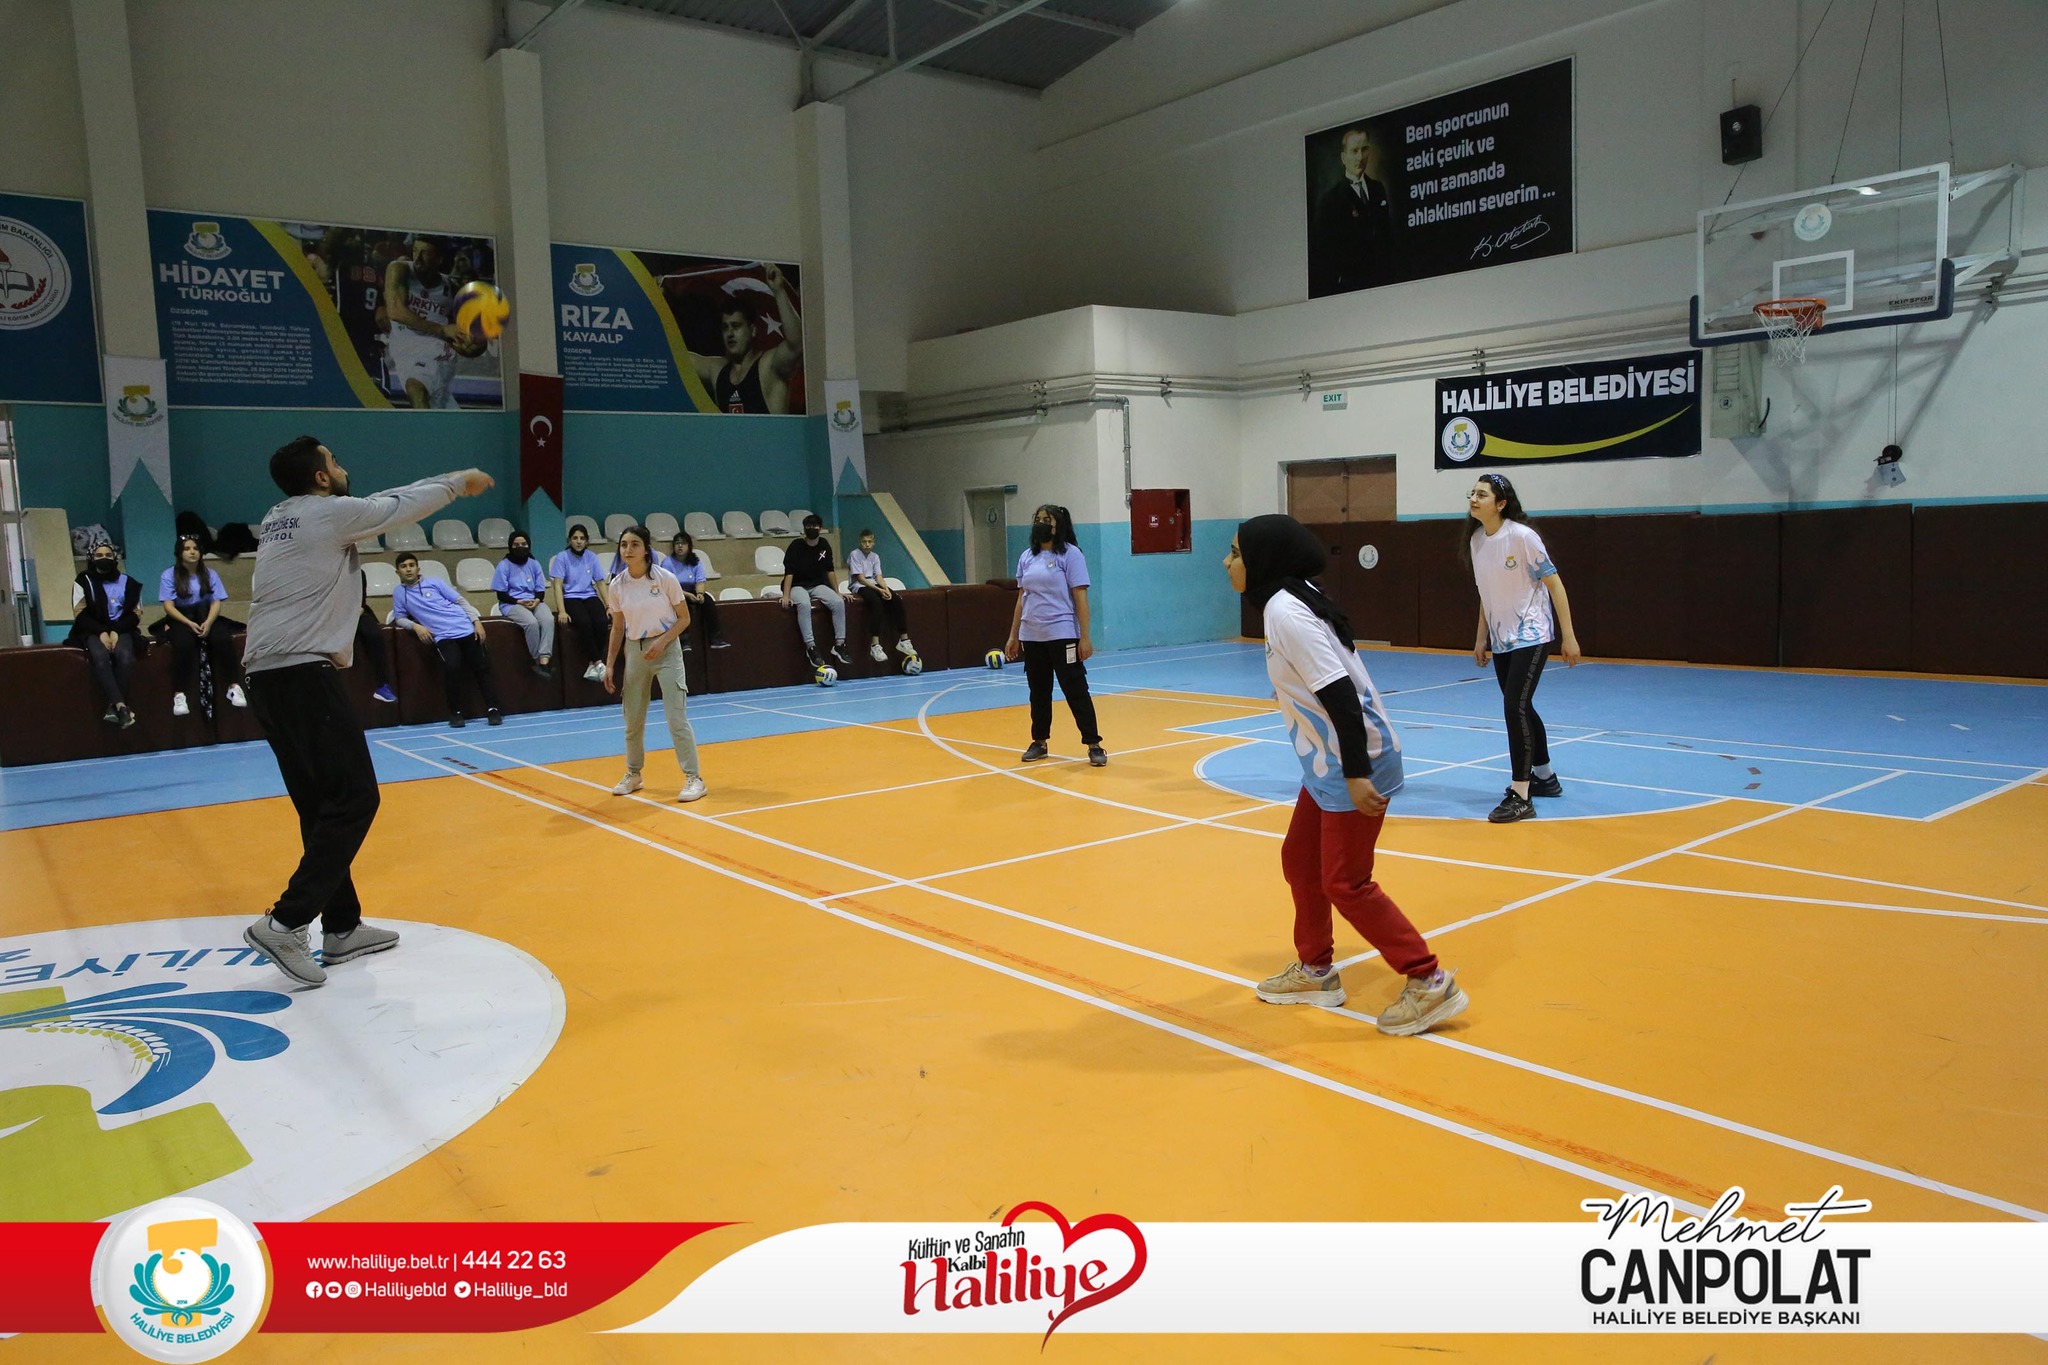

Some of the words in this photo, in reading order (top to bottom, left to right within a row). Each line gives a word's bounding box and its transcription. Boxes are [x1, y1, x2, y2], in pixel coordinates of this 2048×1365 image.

[1406, 125, 1432, 144] Ben
[1434, 102, 1509, 137] sporcunun
[1406, 150, 1433, 172] zeki
[1437, 139, 1474, 168] çevik
[1477, 136, 1495, 154] ve
[1410, 179, 1438, 200] aynı
[1440, 162, 1505, 191] zamanda
[1407, 200, 1476, 227] ahlaklısını
[1479, 184, 1539, 213] severim
[160, 260, 285, 289] HİDAYET
[177, 285, 272, 304] TÜRKOĞLU
[365, 287, 379, 310] 9
[561, 304, 634, 330] RIZA
[563, 331, 624, 344] KAYAALP
[1323, 393, 1342, 402] EXIT
[1442, 378, 1543, 414] HALİLİYE
[1548, 359, 1695, 405] BELEDİYESİ
